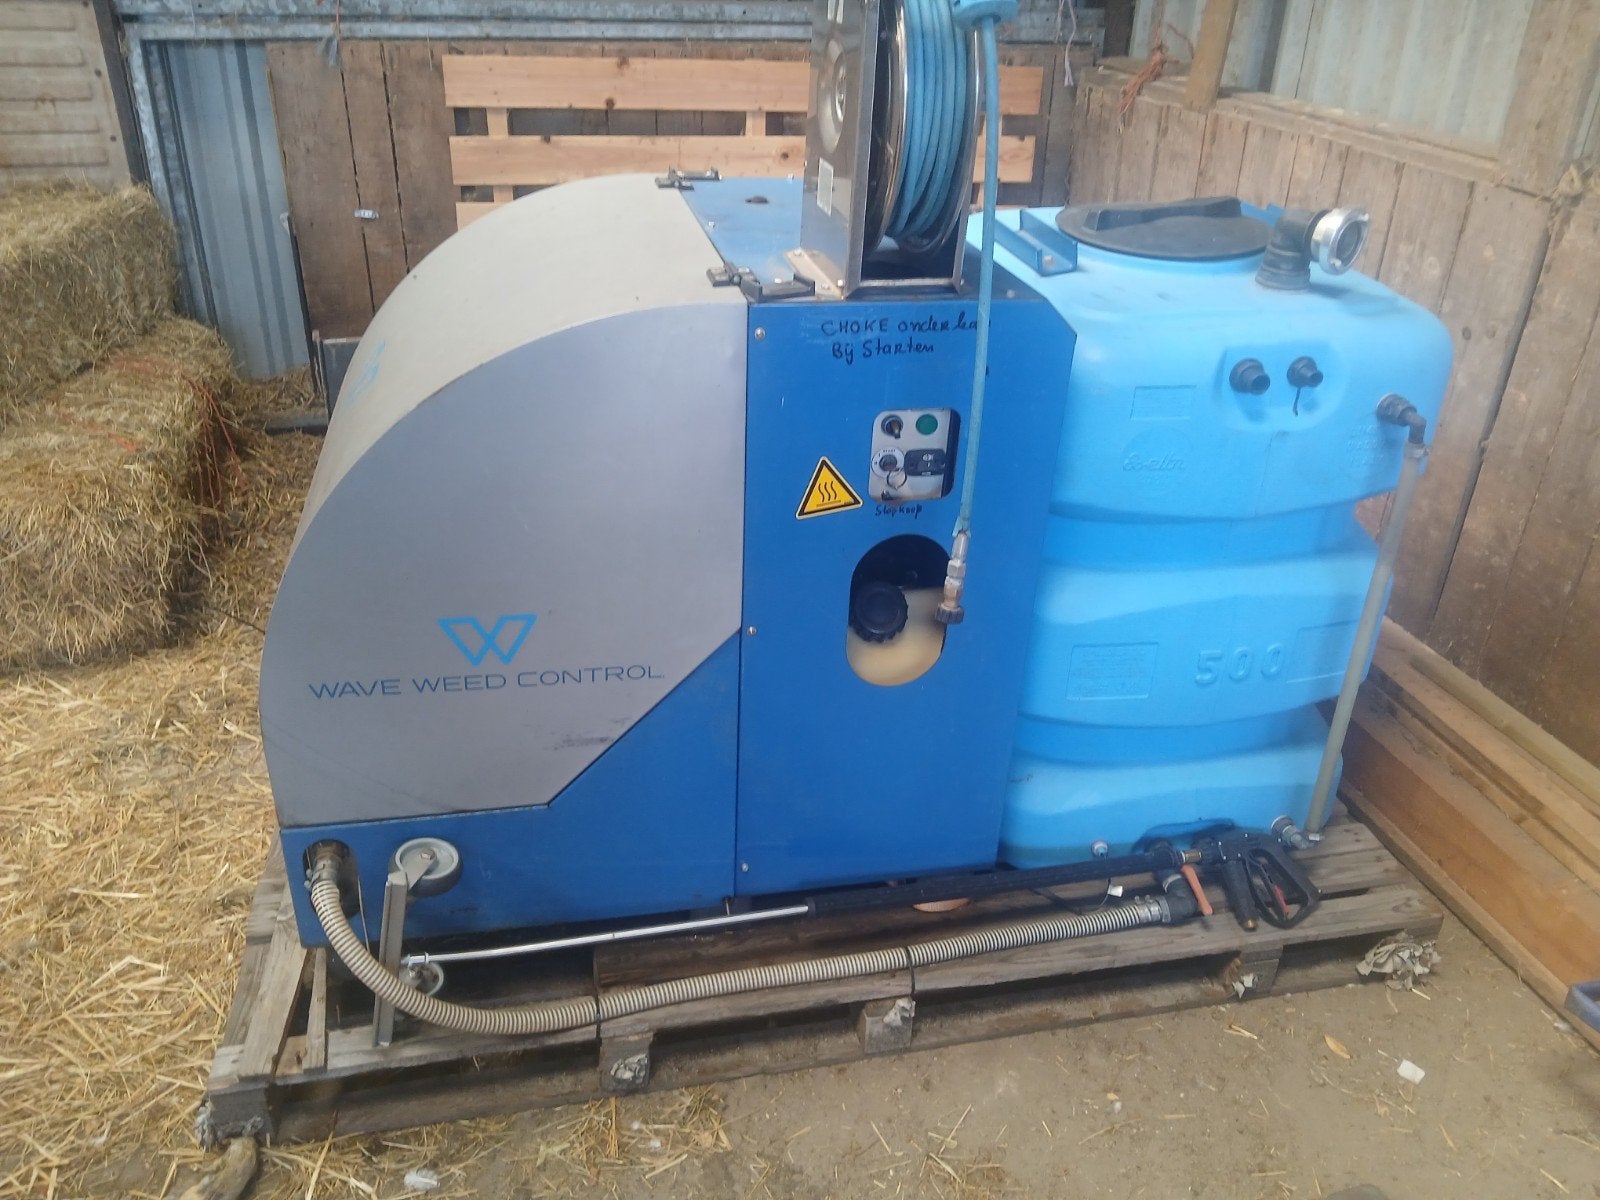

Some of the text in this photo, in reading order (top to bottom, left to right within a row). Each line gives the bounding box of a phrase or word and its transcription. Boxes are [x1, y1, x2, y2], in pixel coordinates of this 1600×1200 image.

[820, 317, 889, 336] CHOKE
[1194, 642, 1283, 685] 500
[308, 664, 665, 700] WAVE WEED CONTROL
